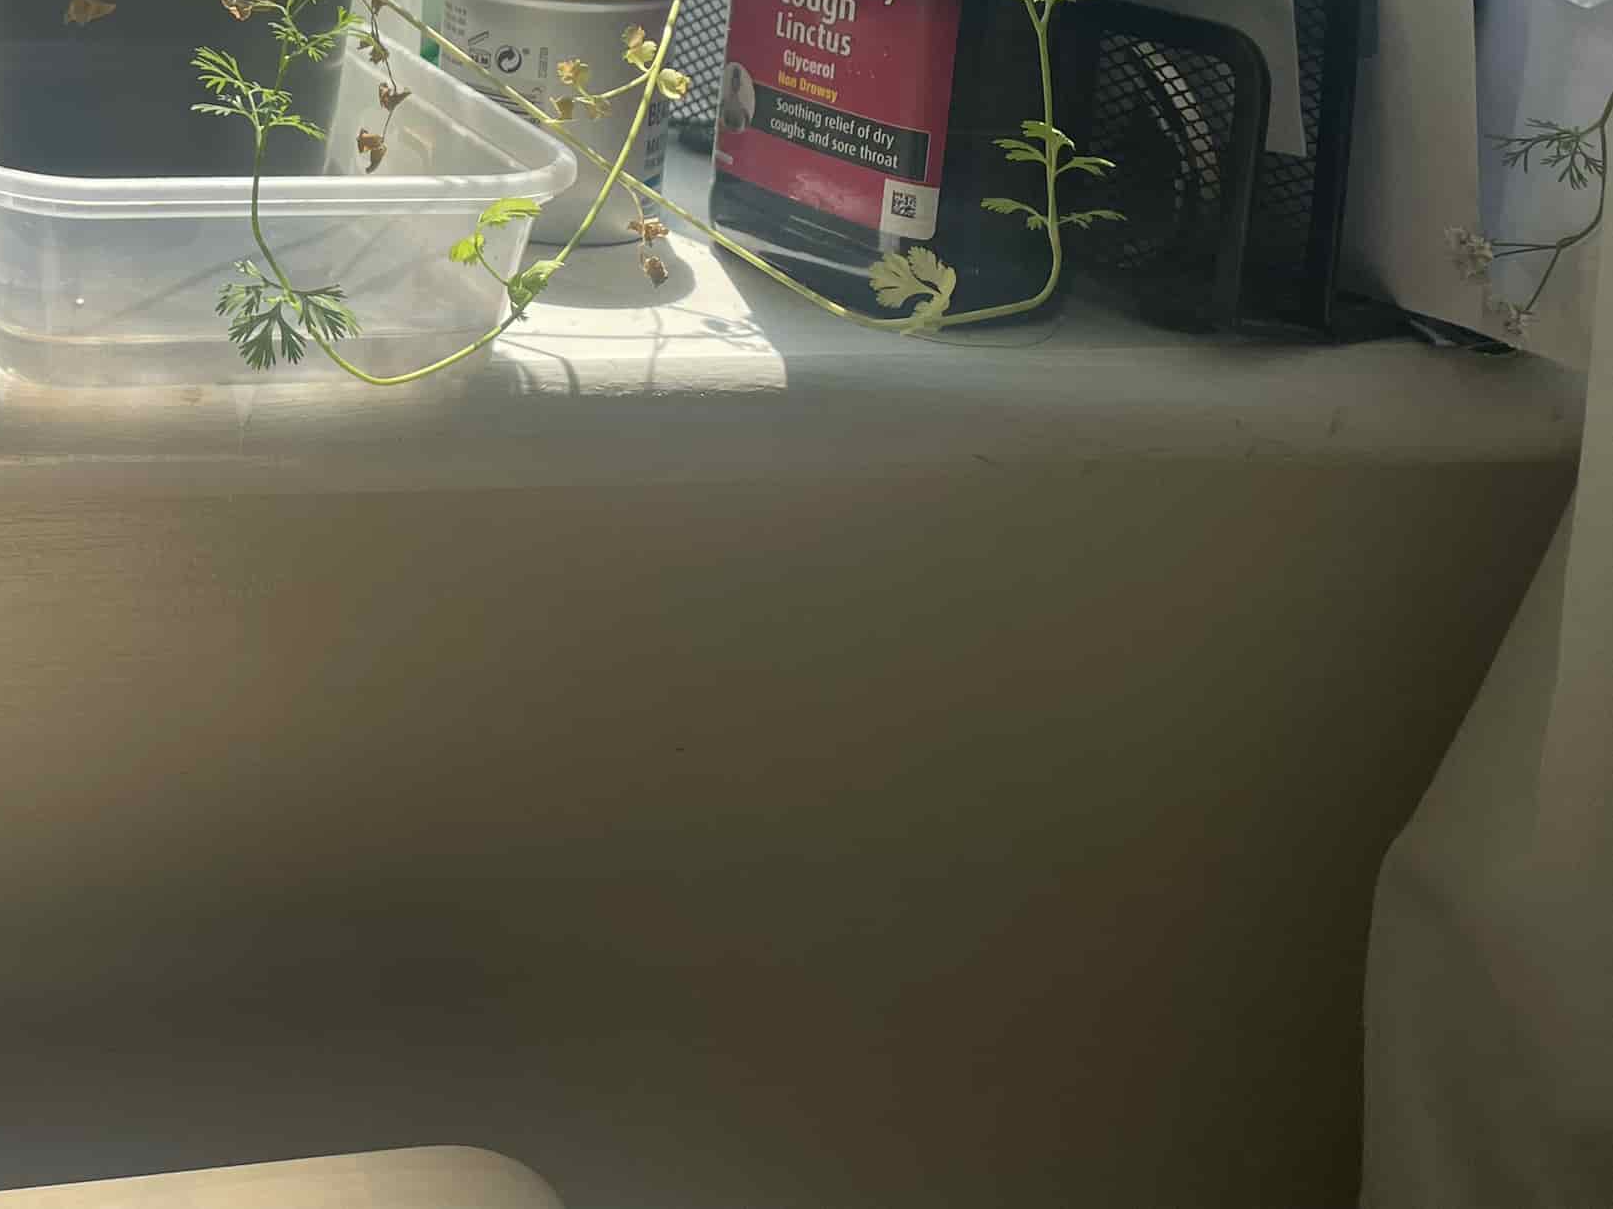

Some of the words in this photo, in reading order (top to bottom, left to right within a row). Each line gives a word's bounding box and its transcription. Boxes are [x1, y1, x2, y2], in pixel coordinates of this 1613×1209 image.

[776, 11, 852, 56] Linctus
[778, 70, 797, 88] Non
[799, 77, 838, 103] Drowsy
[783, 49, 836, 79] Glycerol
[770, 117, 806, 143] coughs
[808, 130, 829, 148] and
[831, 137, 857, 156] sore
[860, 145, 899, 169] throat
[776, 97, 823, 129] Soothing
[824, 115, 856, 135] relief
[857, 124, 871, 141] of
[873, 130, 895, 151] dry
